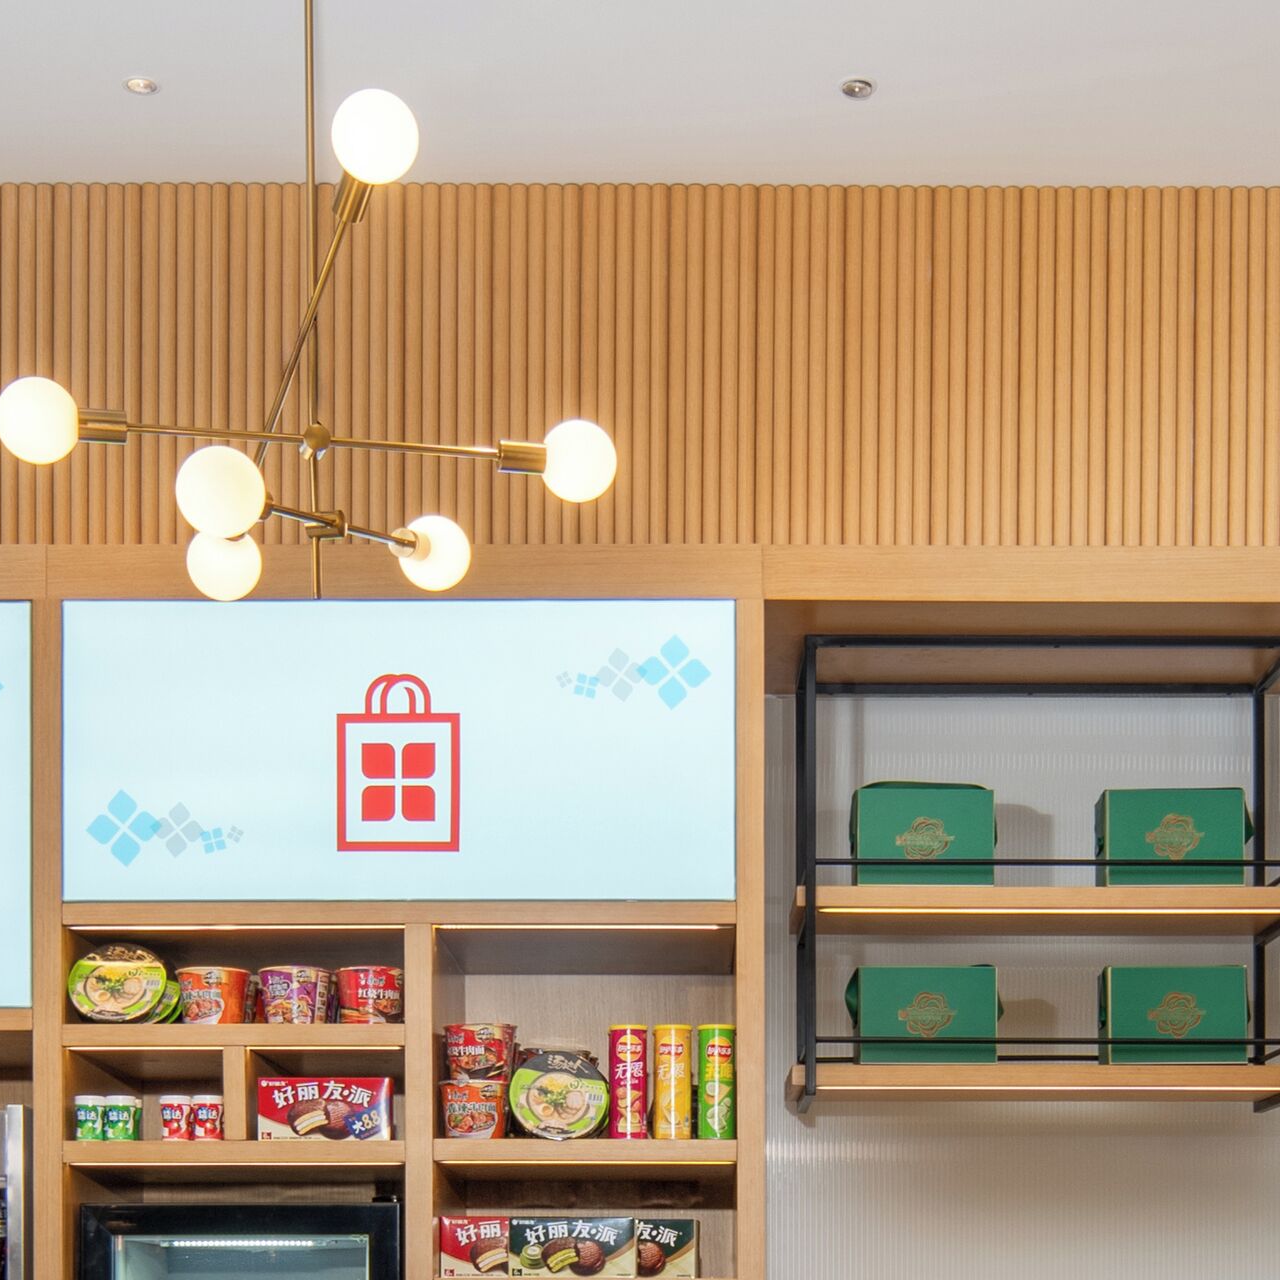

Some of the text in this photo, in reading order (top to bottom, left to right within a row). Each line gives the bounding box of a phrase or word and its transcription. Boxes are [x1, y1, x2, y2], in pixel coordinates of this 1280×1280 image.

[615, 1062, 645, 1079] 无限
[272, 1081, 372, 1108] 好丽友·派
[456, 1220, 508, 1246] 好丽
[524, 1221, 619, 1246] 好丽友·派
